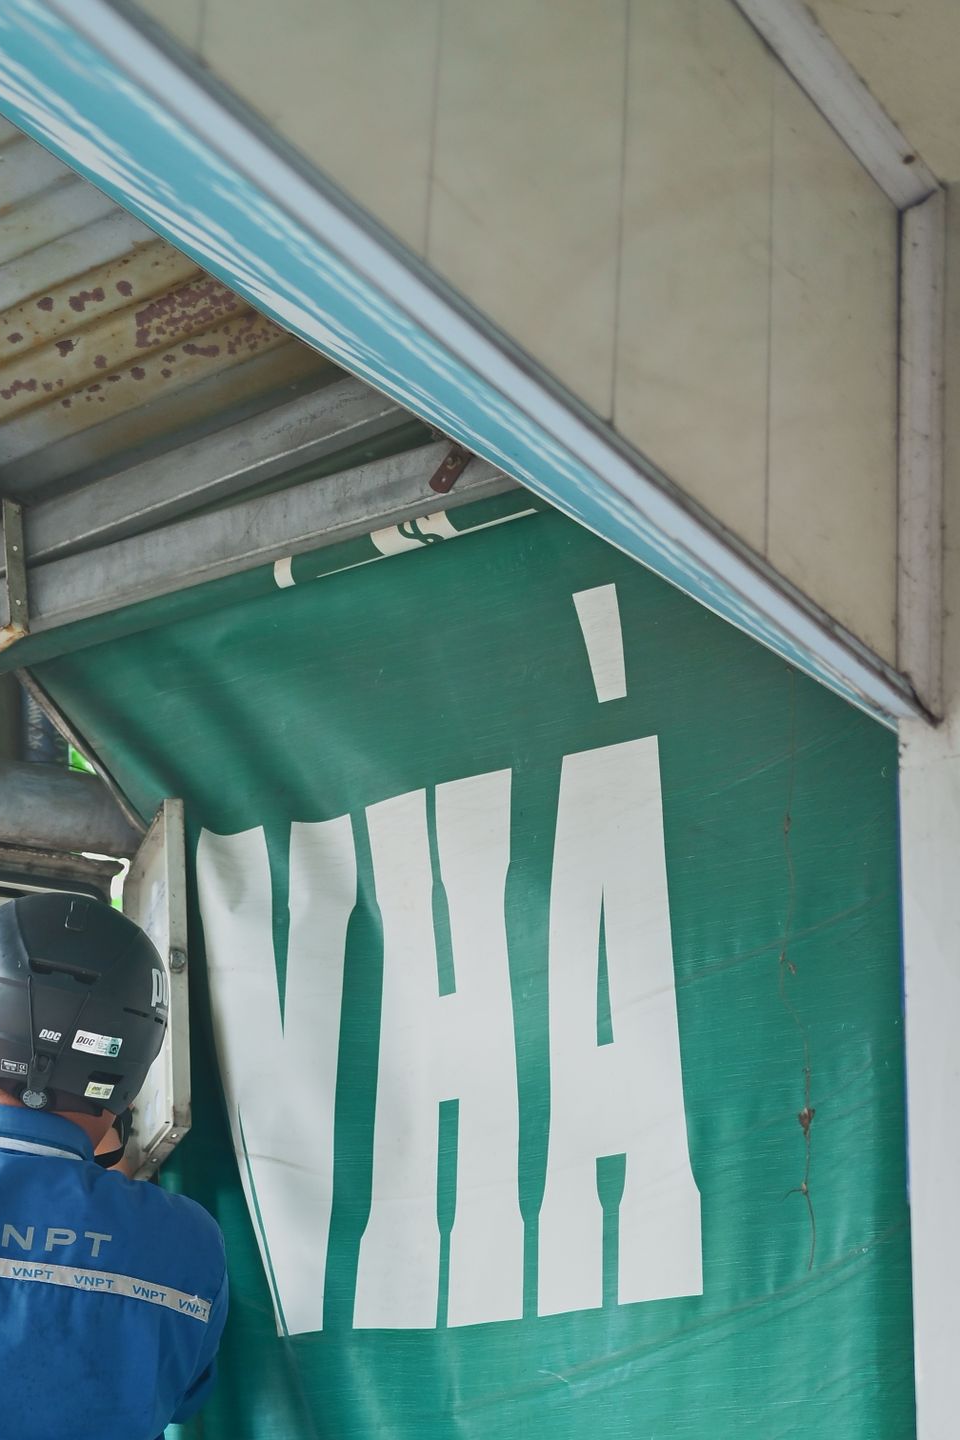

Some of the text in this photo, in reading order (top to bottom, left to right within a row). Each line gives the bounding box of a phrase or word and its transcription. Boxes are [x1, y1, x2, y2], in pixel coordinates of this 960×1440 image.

[12, 1266, 54, 1280] VNPT
[73, 1274, 115, 1290] VNPT
[132, 1284, 167, 1303] VNPT
[178, 1298, 208, 1318] VNPT
